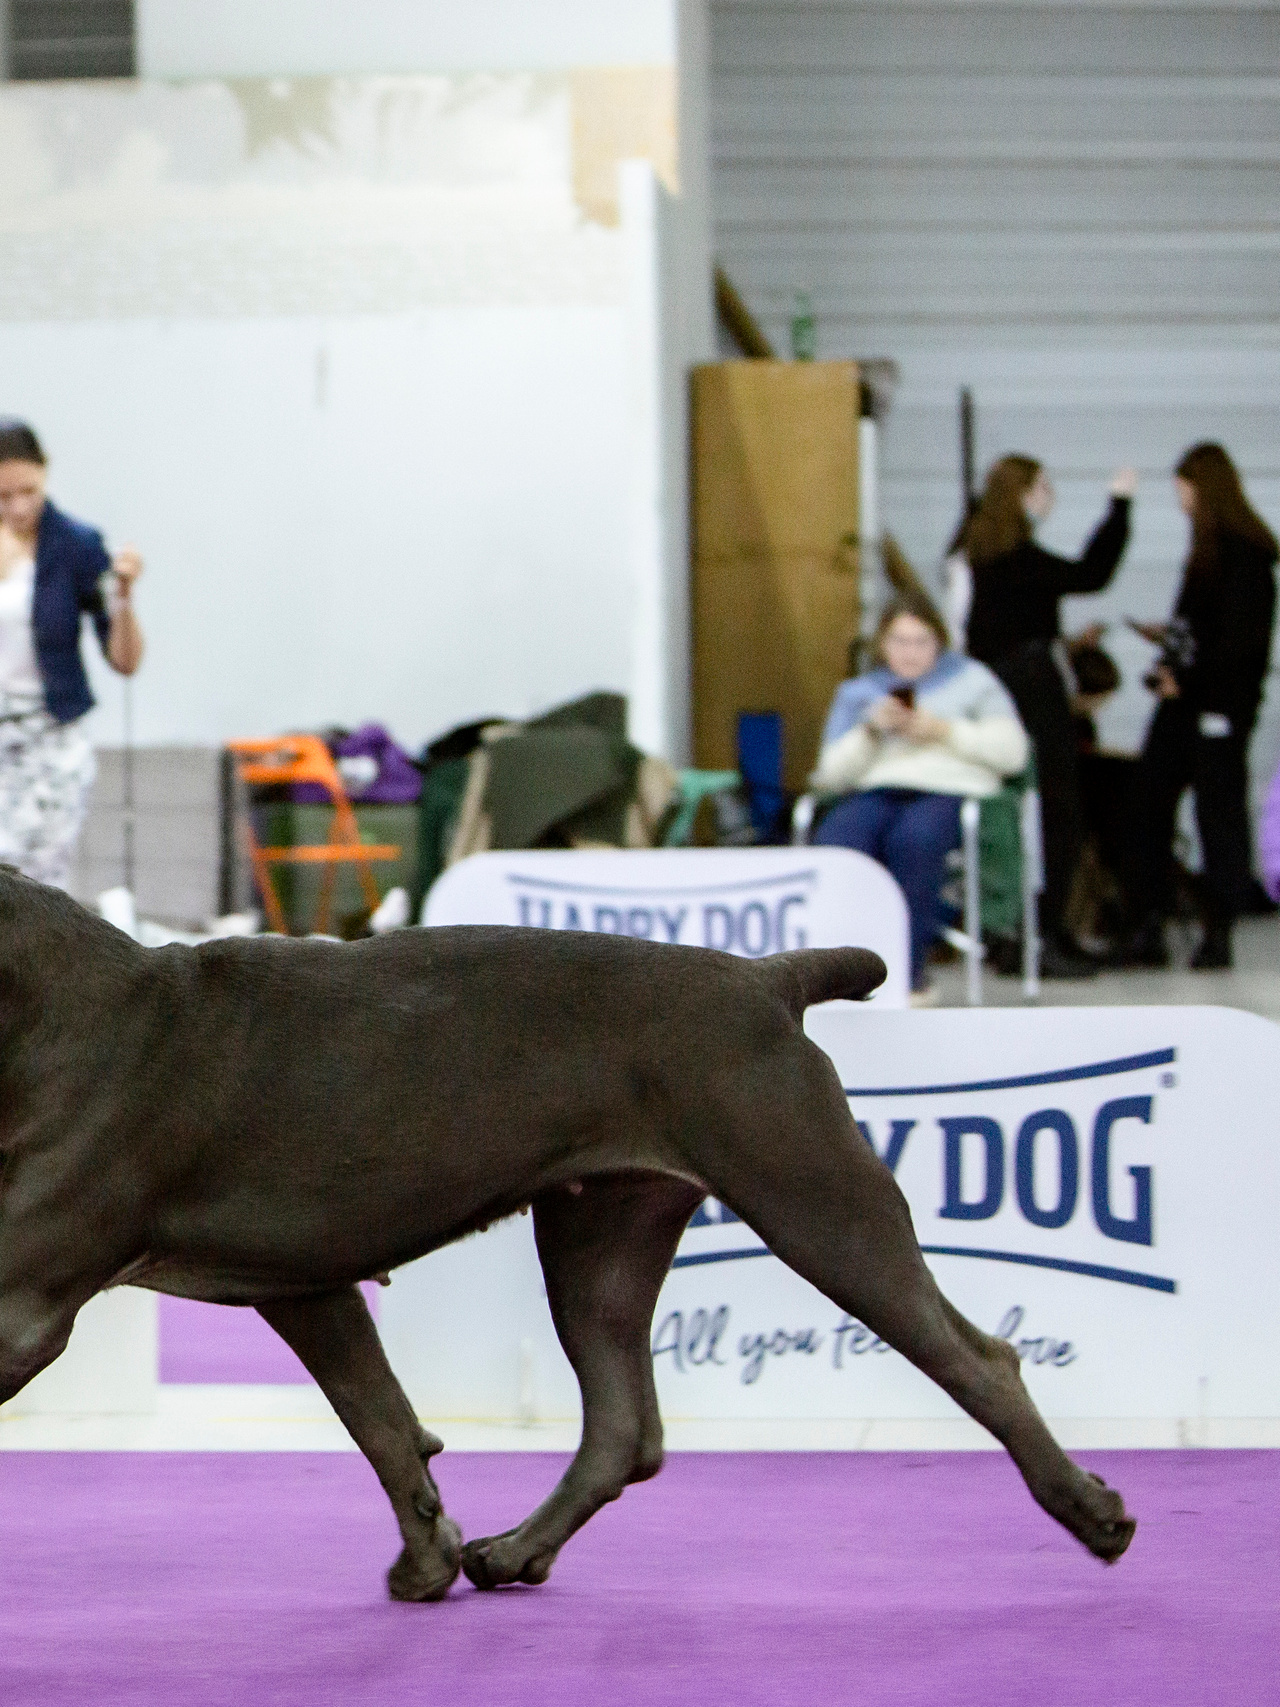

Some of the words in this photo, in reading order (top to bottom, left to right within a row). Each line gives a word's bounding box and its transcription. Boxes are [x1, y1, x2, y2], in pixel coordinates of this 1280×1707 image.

[703, 893, 807, 957] DOG
[936, 1095, 1154, 1247] DOG
[652, 1304, 728, 1374] All
[738, 1327, 823, 1385] you
